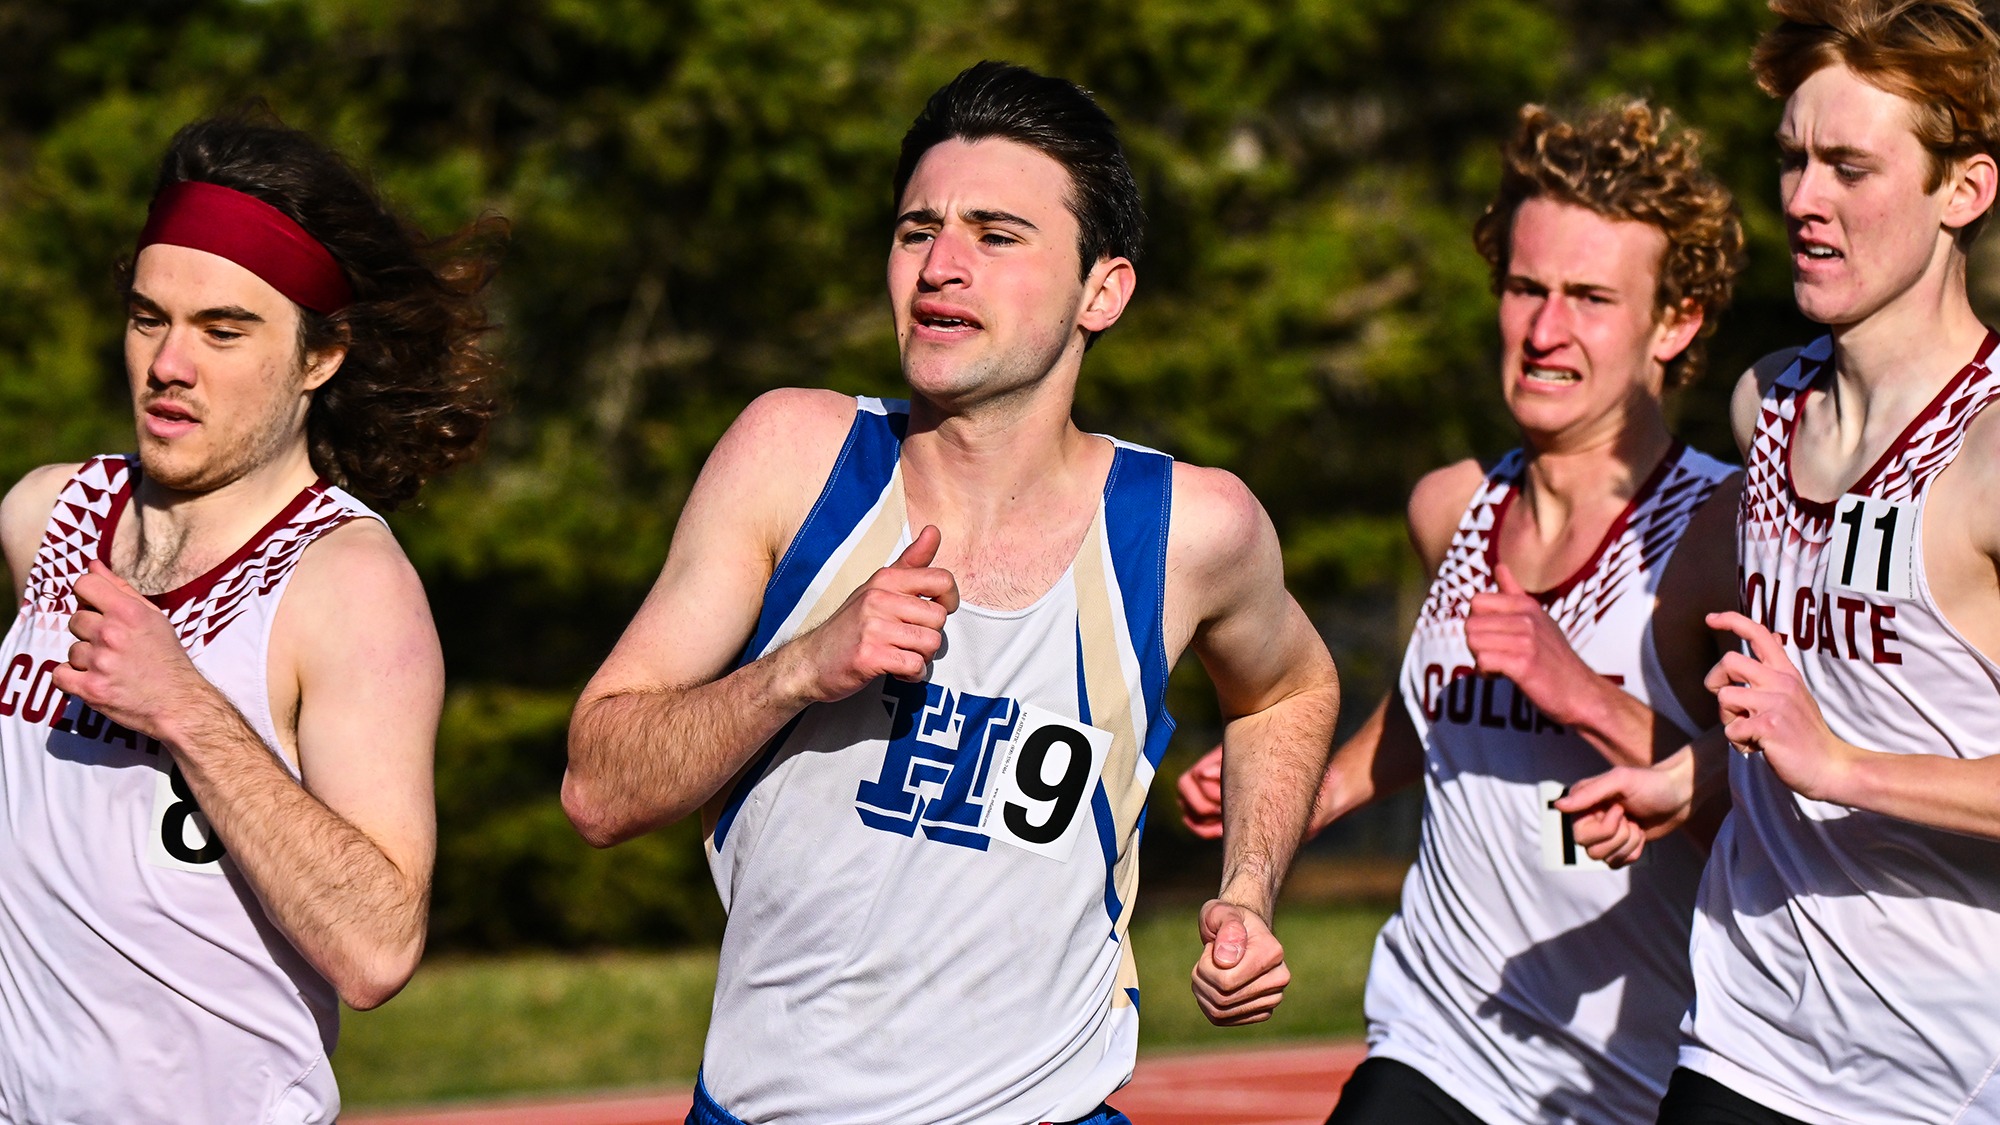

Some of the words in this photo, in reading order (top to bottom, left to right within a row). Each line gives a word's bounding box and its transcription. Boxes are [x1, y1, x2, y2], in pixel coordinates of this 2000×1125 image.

[1841, 501, 1899, 592] 11
[855, 670, 1020, 852] H
[1003, 724, 1093, 844] 9
[1547, 785, 1577, 866] 1
